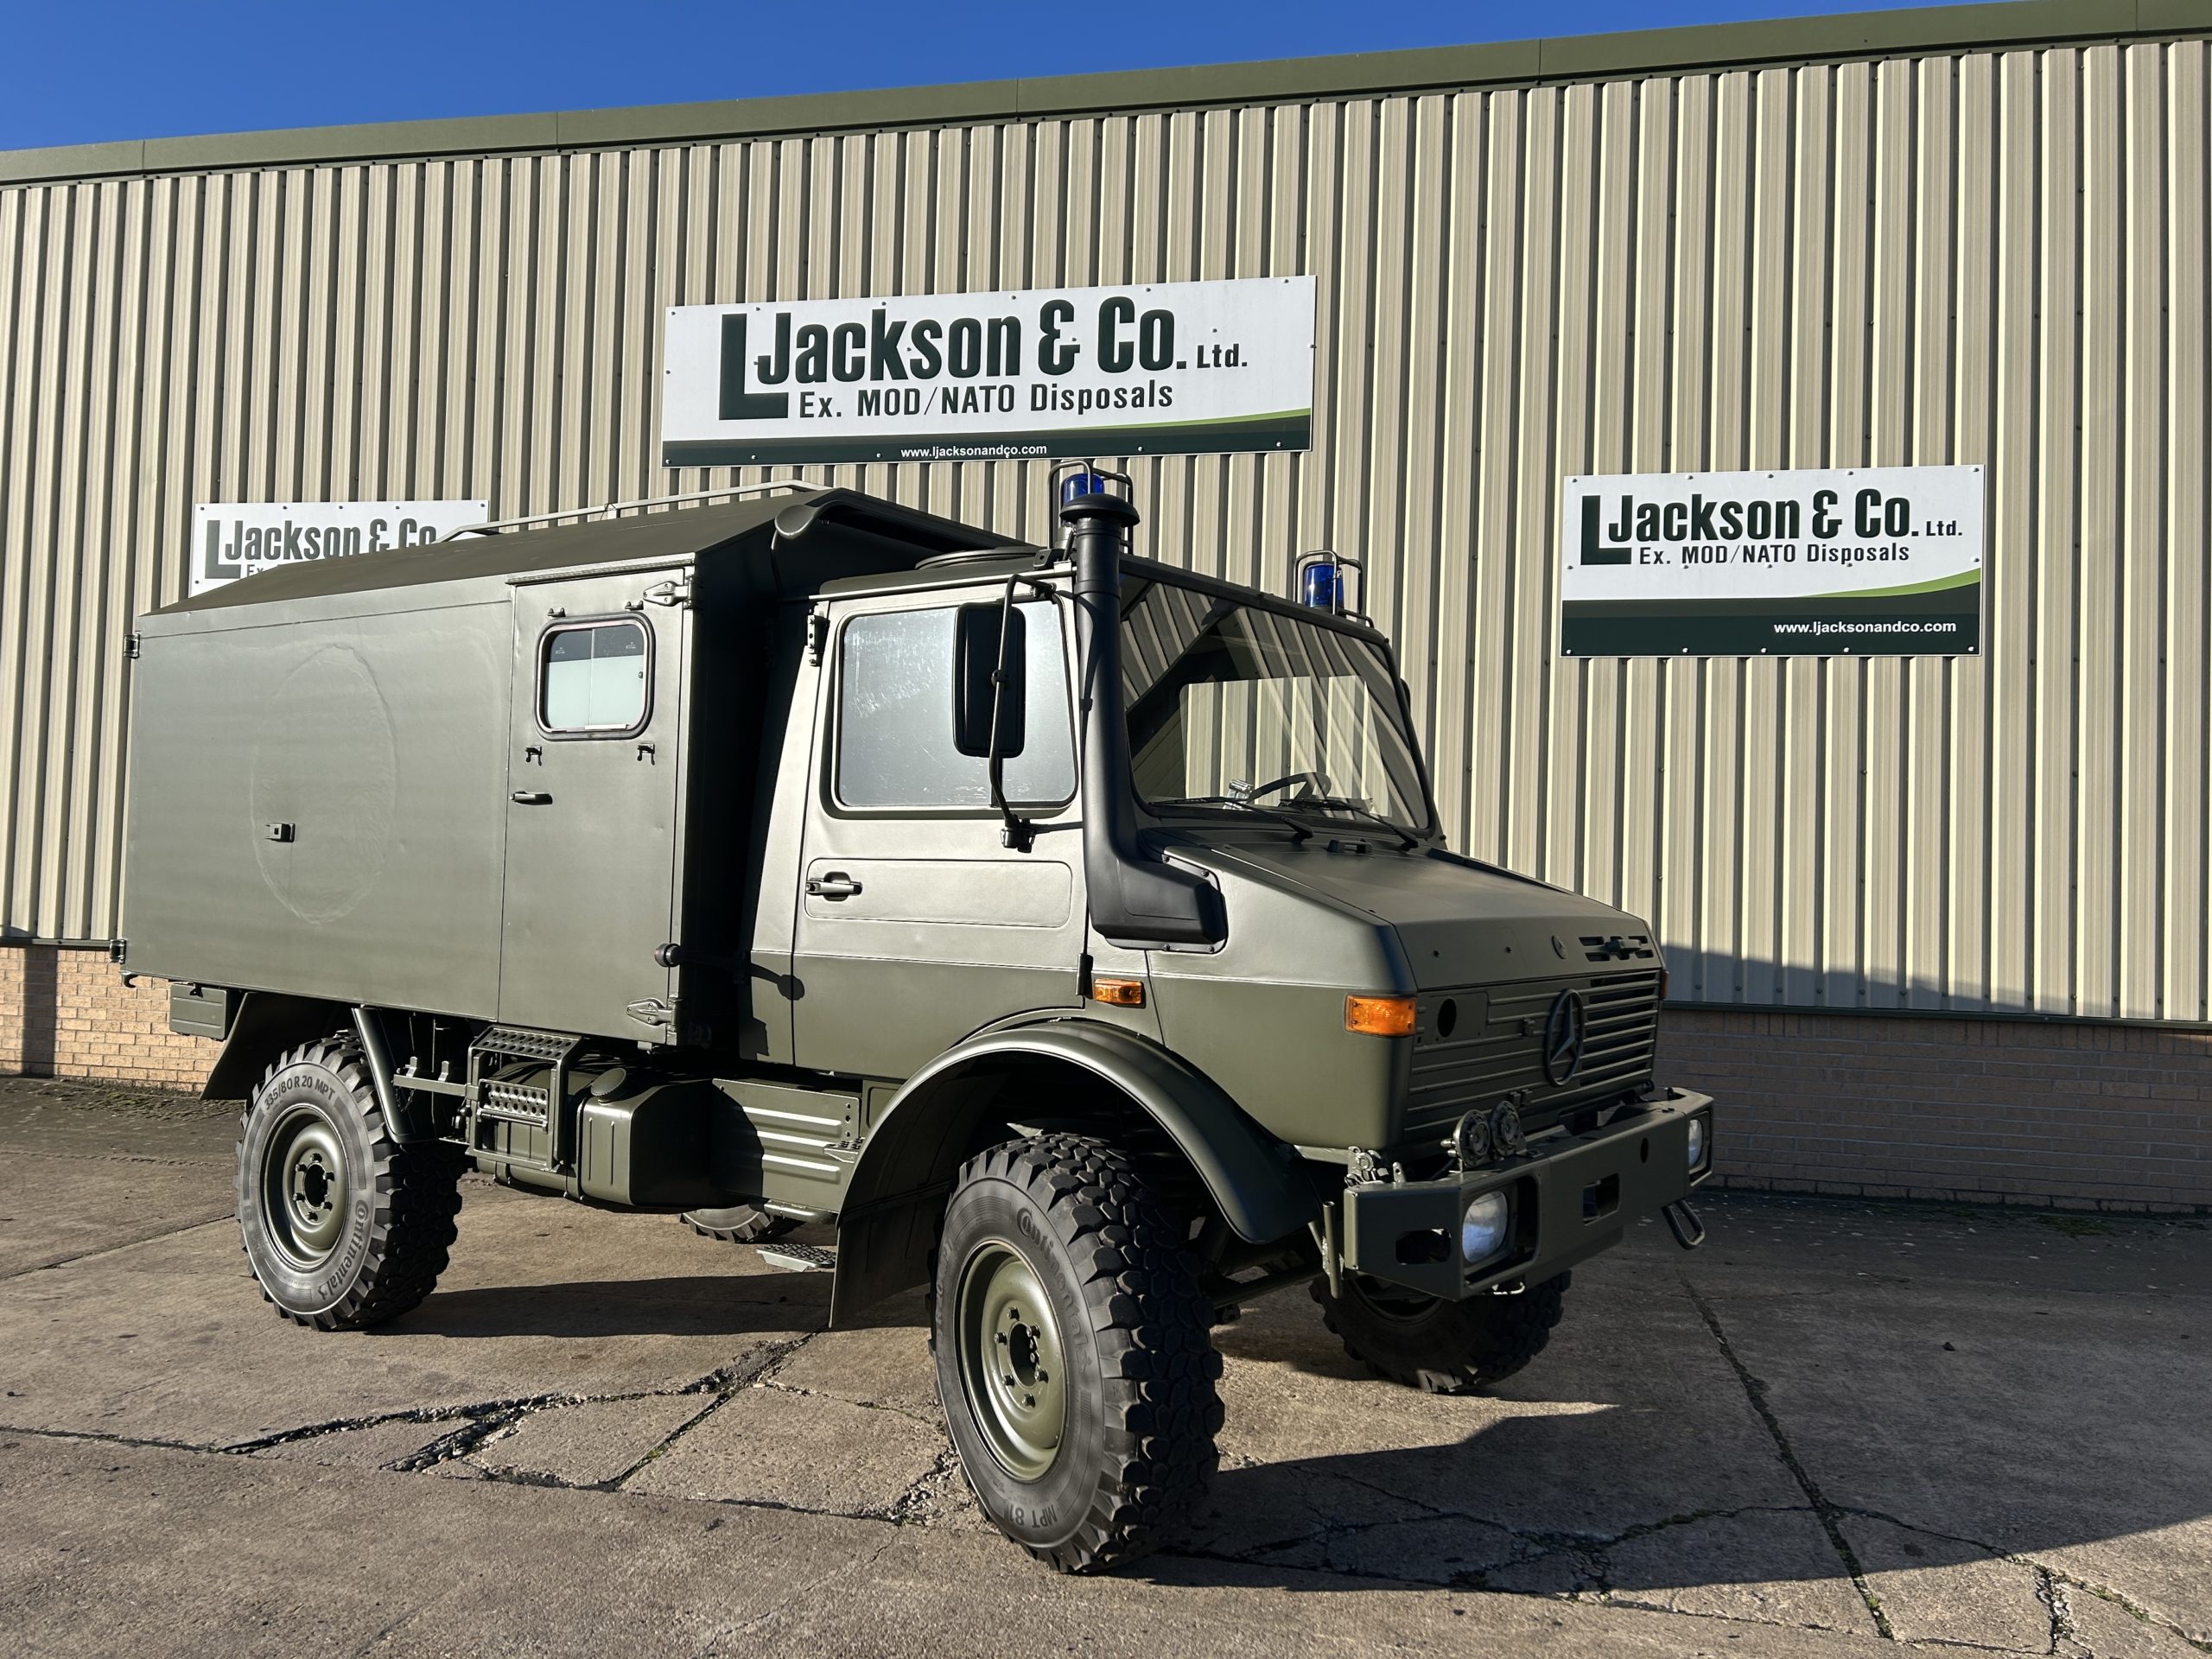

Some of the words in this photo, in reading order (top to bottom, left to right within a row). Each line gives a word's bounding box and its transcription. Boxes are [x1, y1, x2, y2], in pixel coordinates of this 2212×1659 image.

[1038, 299, 1080, 376] &
[1097, 296, 1187, 373] Co.
[1197, 343, 1248, 369] Ltd.
[800, 391, 842, 418] Ex.
[857, 384, 1014, 417] MOD/NATO
[1031, 379, 1173, 415] Disposals
[901, 444, 1047, 460] www.ljacksonandco.com
[1812, 490, 1842, 539] &
[1855, 488, 1919, 538] Co.
[1926, 520, 1962, 537] Ltd.
[369, 518, 390, 552] &
[1640, 547, 1671, 564] Ex.
[1681, 543, 1796, 564] MOD/NATO
[1807, 543, 1910, 565] Disposals
[1774, 620, 1957, 636] www.ljacksonandco.com
[264, 1078, 293, 1110] 335/80
[315, 1078, 336, 1101] MPT
[327, 1199, 369, 1296] Continental
[1017, 1208, 1090, 1347] Continental
[1009, 1503, 1025, 1526] 81
[1032, 1503, 1058, 1529] MPT
